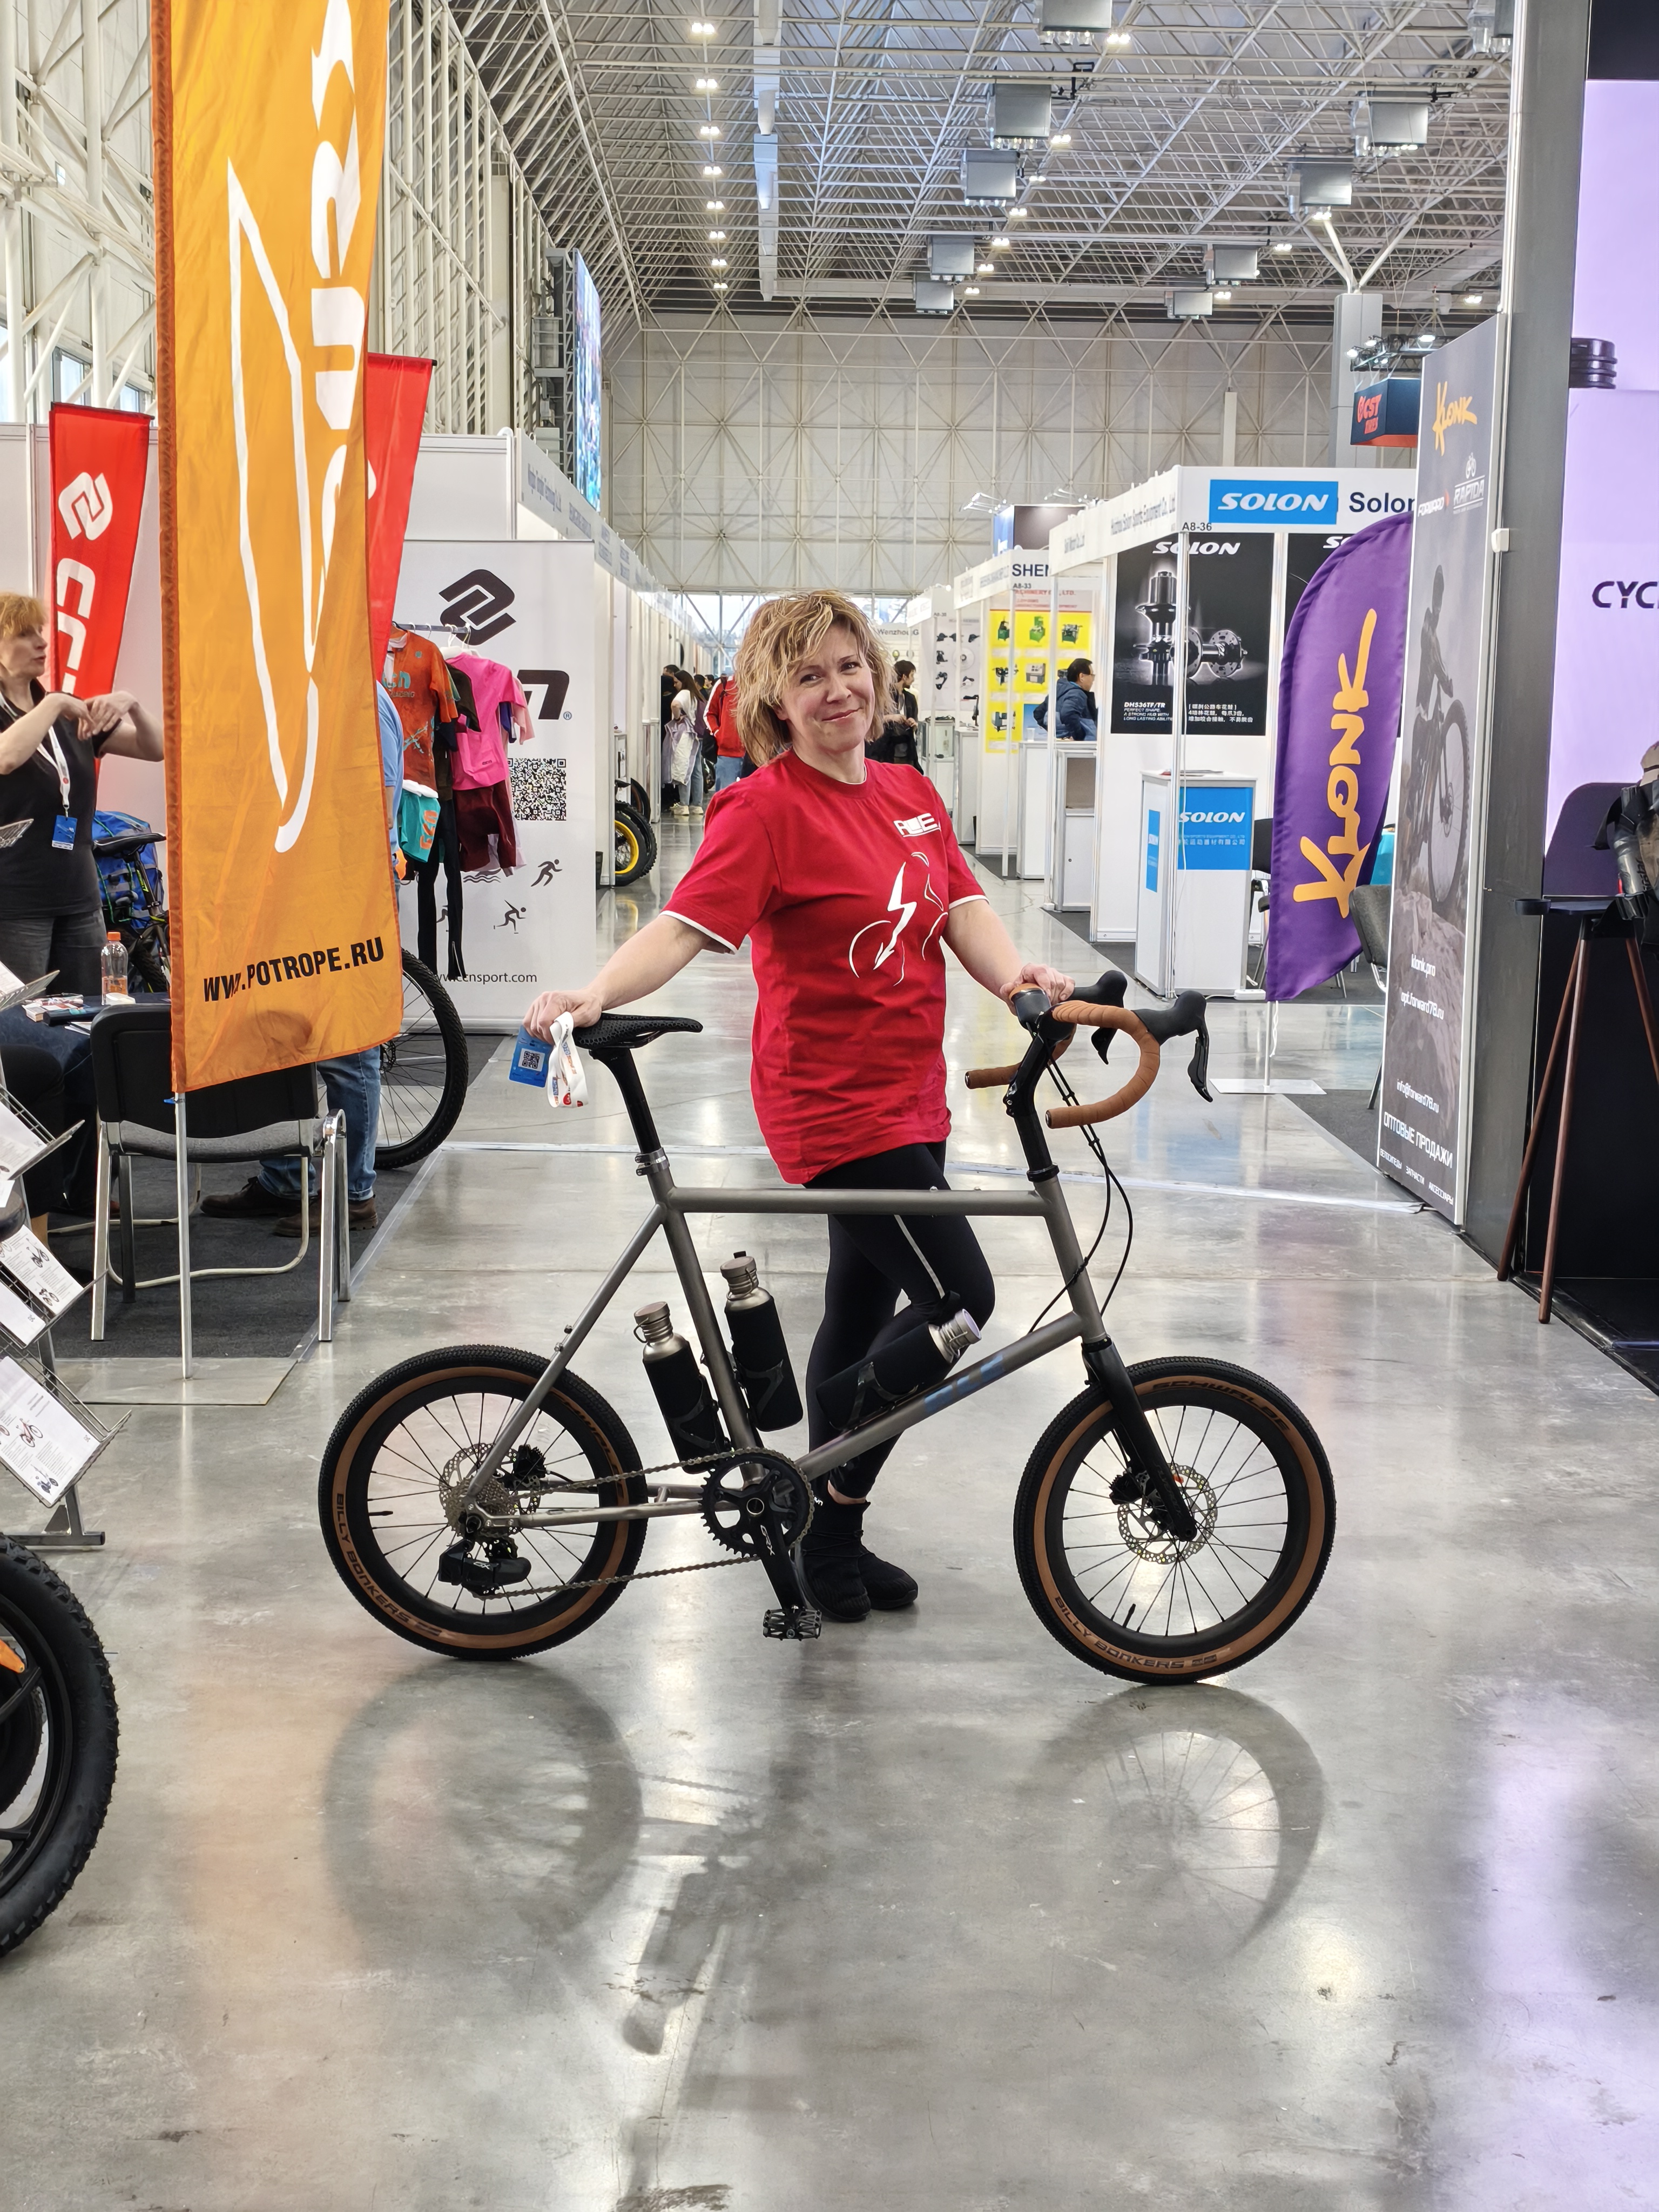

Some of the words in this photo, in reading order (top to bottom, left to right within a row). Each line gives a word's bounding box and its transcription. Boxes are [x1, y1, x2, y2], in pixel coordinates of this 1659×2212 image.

[1218, 493, 1329, 511] SOLON
[1453, 479, 1485, 506] RAPIDA
[1182, 522, 1212, 531] A8-36
[1592, 581, 1659, 609] CYC
[1178, 812, 1245, 823] SOLON
[1411, 953, 1436, 979] klonk.pro
[1401, 990, 1445, 1020] opt.forward78.ru
[1397, 1079, 1439, 1113] info@forward78.ru
[1383, 1111, 1415, 1144] ОПТОВЫЕ
[1415, 1131, 1453, 1169] ПРОДАЖИ
[336, 1493, 352, 1543] BILLY
[346, 1550, 412, 1623] BONKERS
[1055, 1597, 1092, 1637] BILLY
[1094, 1641, 1185, 1669] BONKERS
